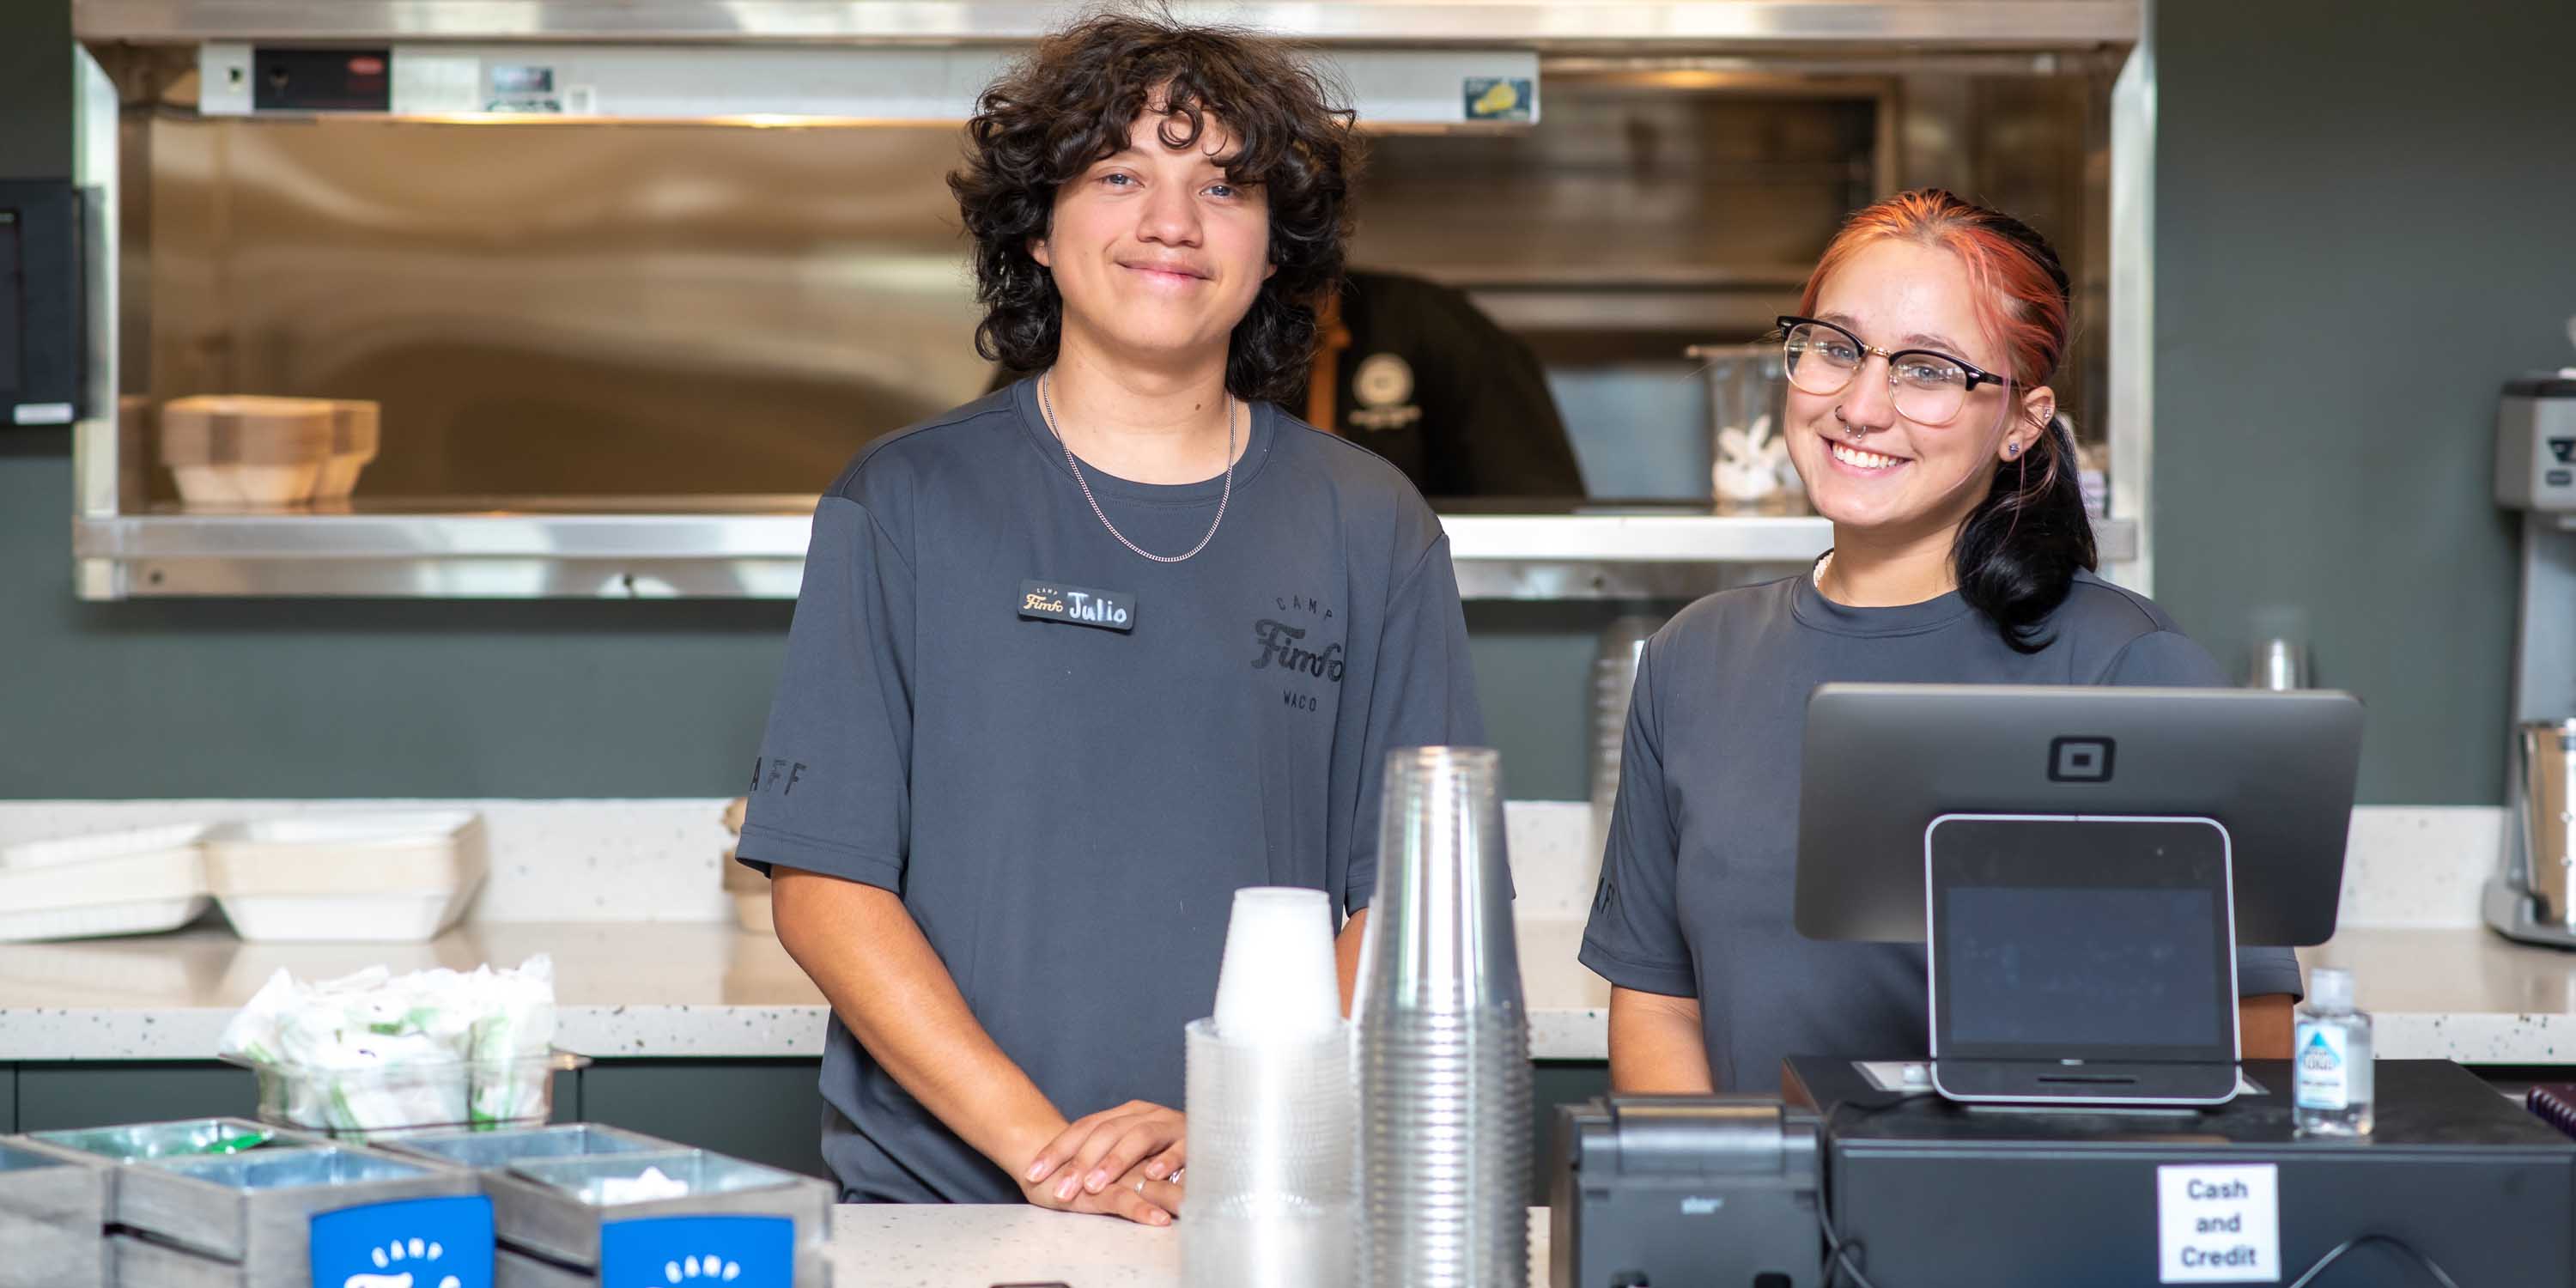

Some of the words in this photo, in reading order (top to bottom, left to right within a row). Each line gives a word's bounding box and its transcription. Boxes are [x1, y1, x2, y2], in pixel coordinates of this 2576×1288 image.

[1067, 592, 1127, 623] Julio
[1276, 594, 1333, 621] CAMP
[1284, 689, 1317, 713] WACO
[2187, 1177, 2249, 1200] Cash
[2196, 1212, 2242, 1234] and
[2181, 1245, 2257, 1267] Credit
